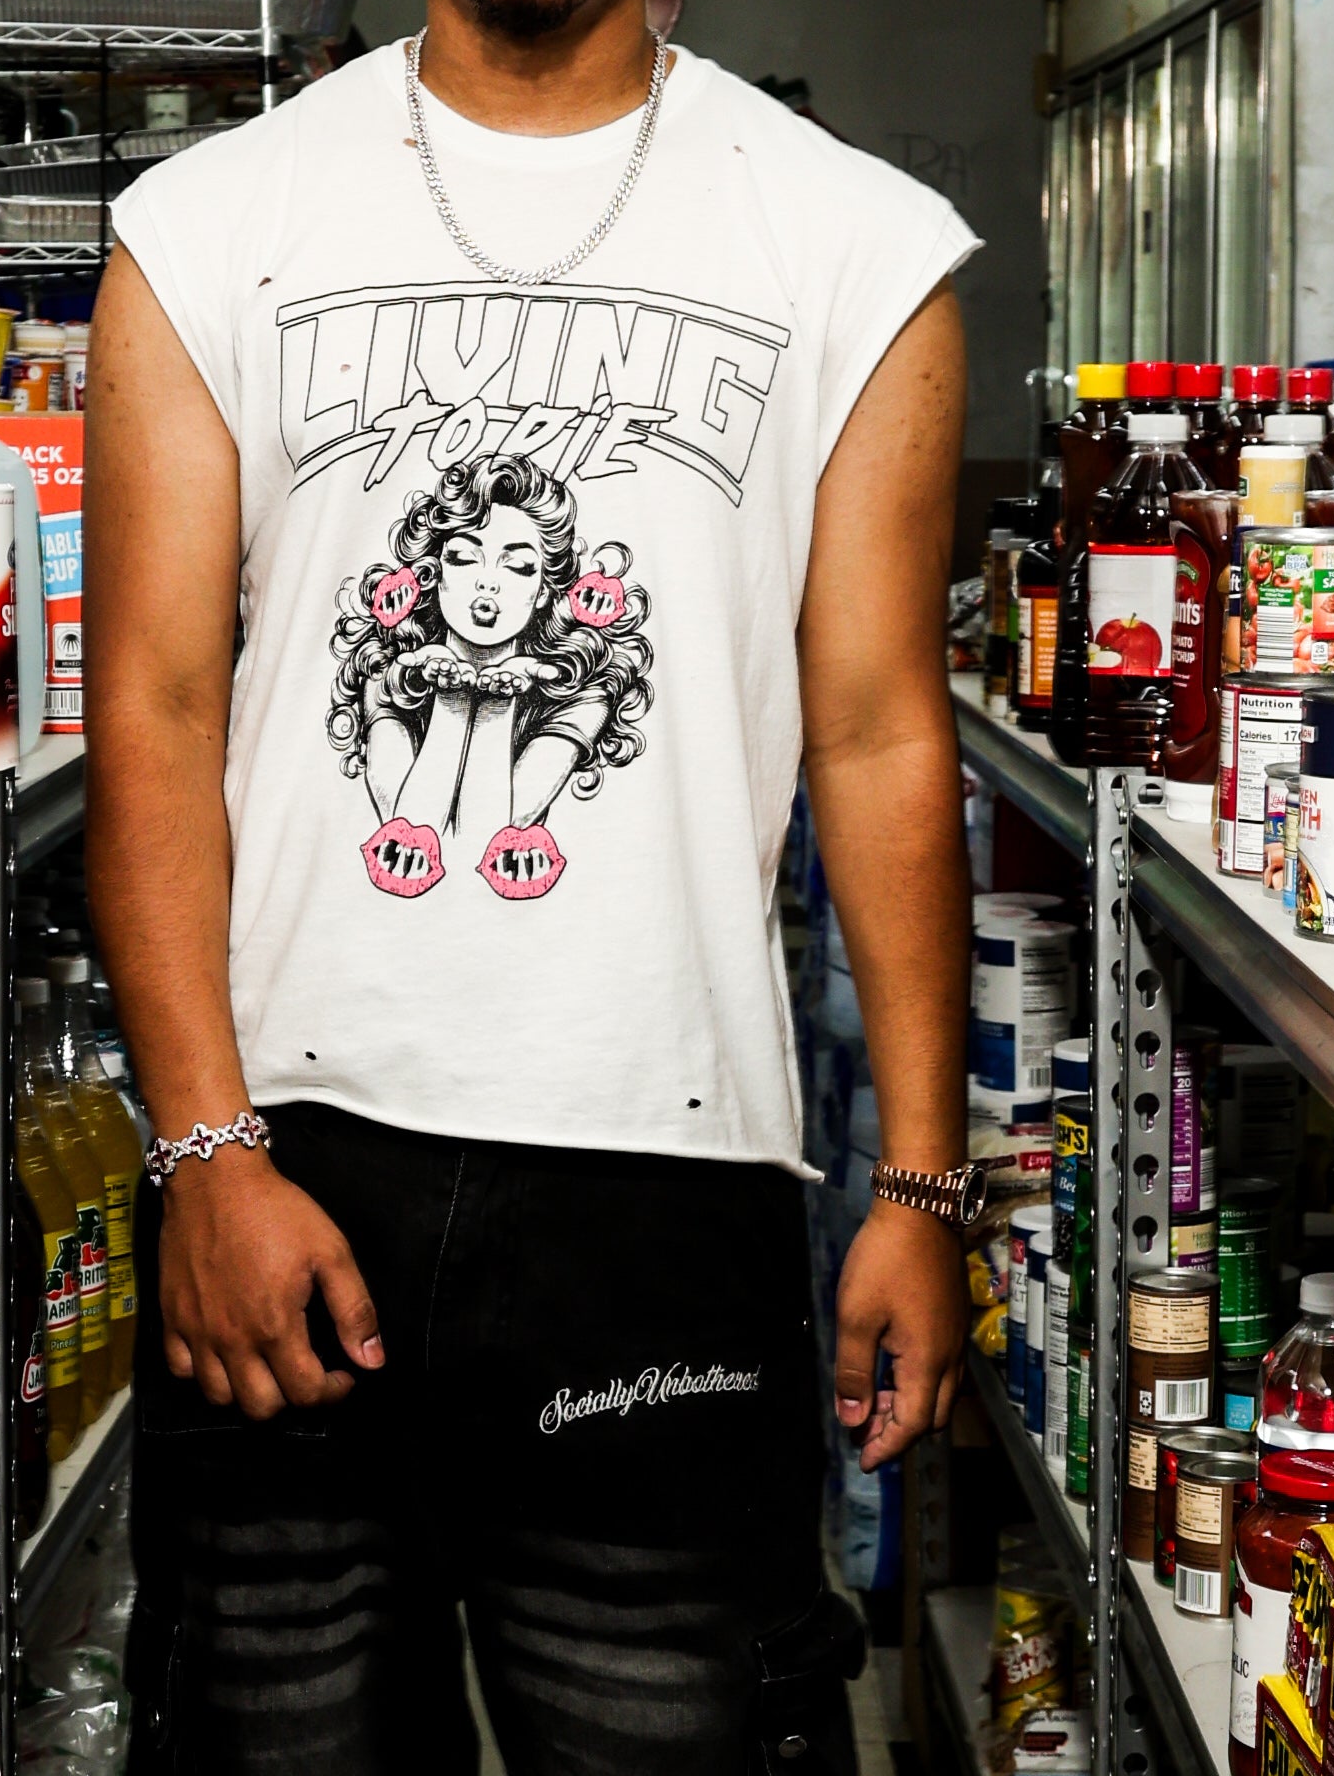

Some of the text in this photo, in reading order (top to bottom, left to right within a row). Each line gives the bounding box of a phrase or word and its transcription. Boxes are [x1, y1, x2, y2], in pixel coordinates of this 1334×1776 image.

[281, 298, 779, 482] LIVING
[366, 390, 678, 492] TO DIE
[54, 468, 83, 484] OZ
[45, 557, 77, 583] CUP
[381, 584, 411, 613] LTD
[581, 586, 615, 613] LTD
[1240, 697, 1293, 709] Nutrition
[1239, 730, 1272, 741] Calories
[378, 840, 426, 876] LTD
[497, 849, 548, 876] LTD
[539, 1378, 636, 1434] Socially
